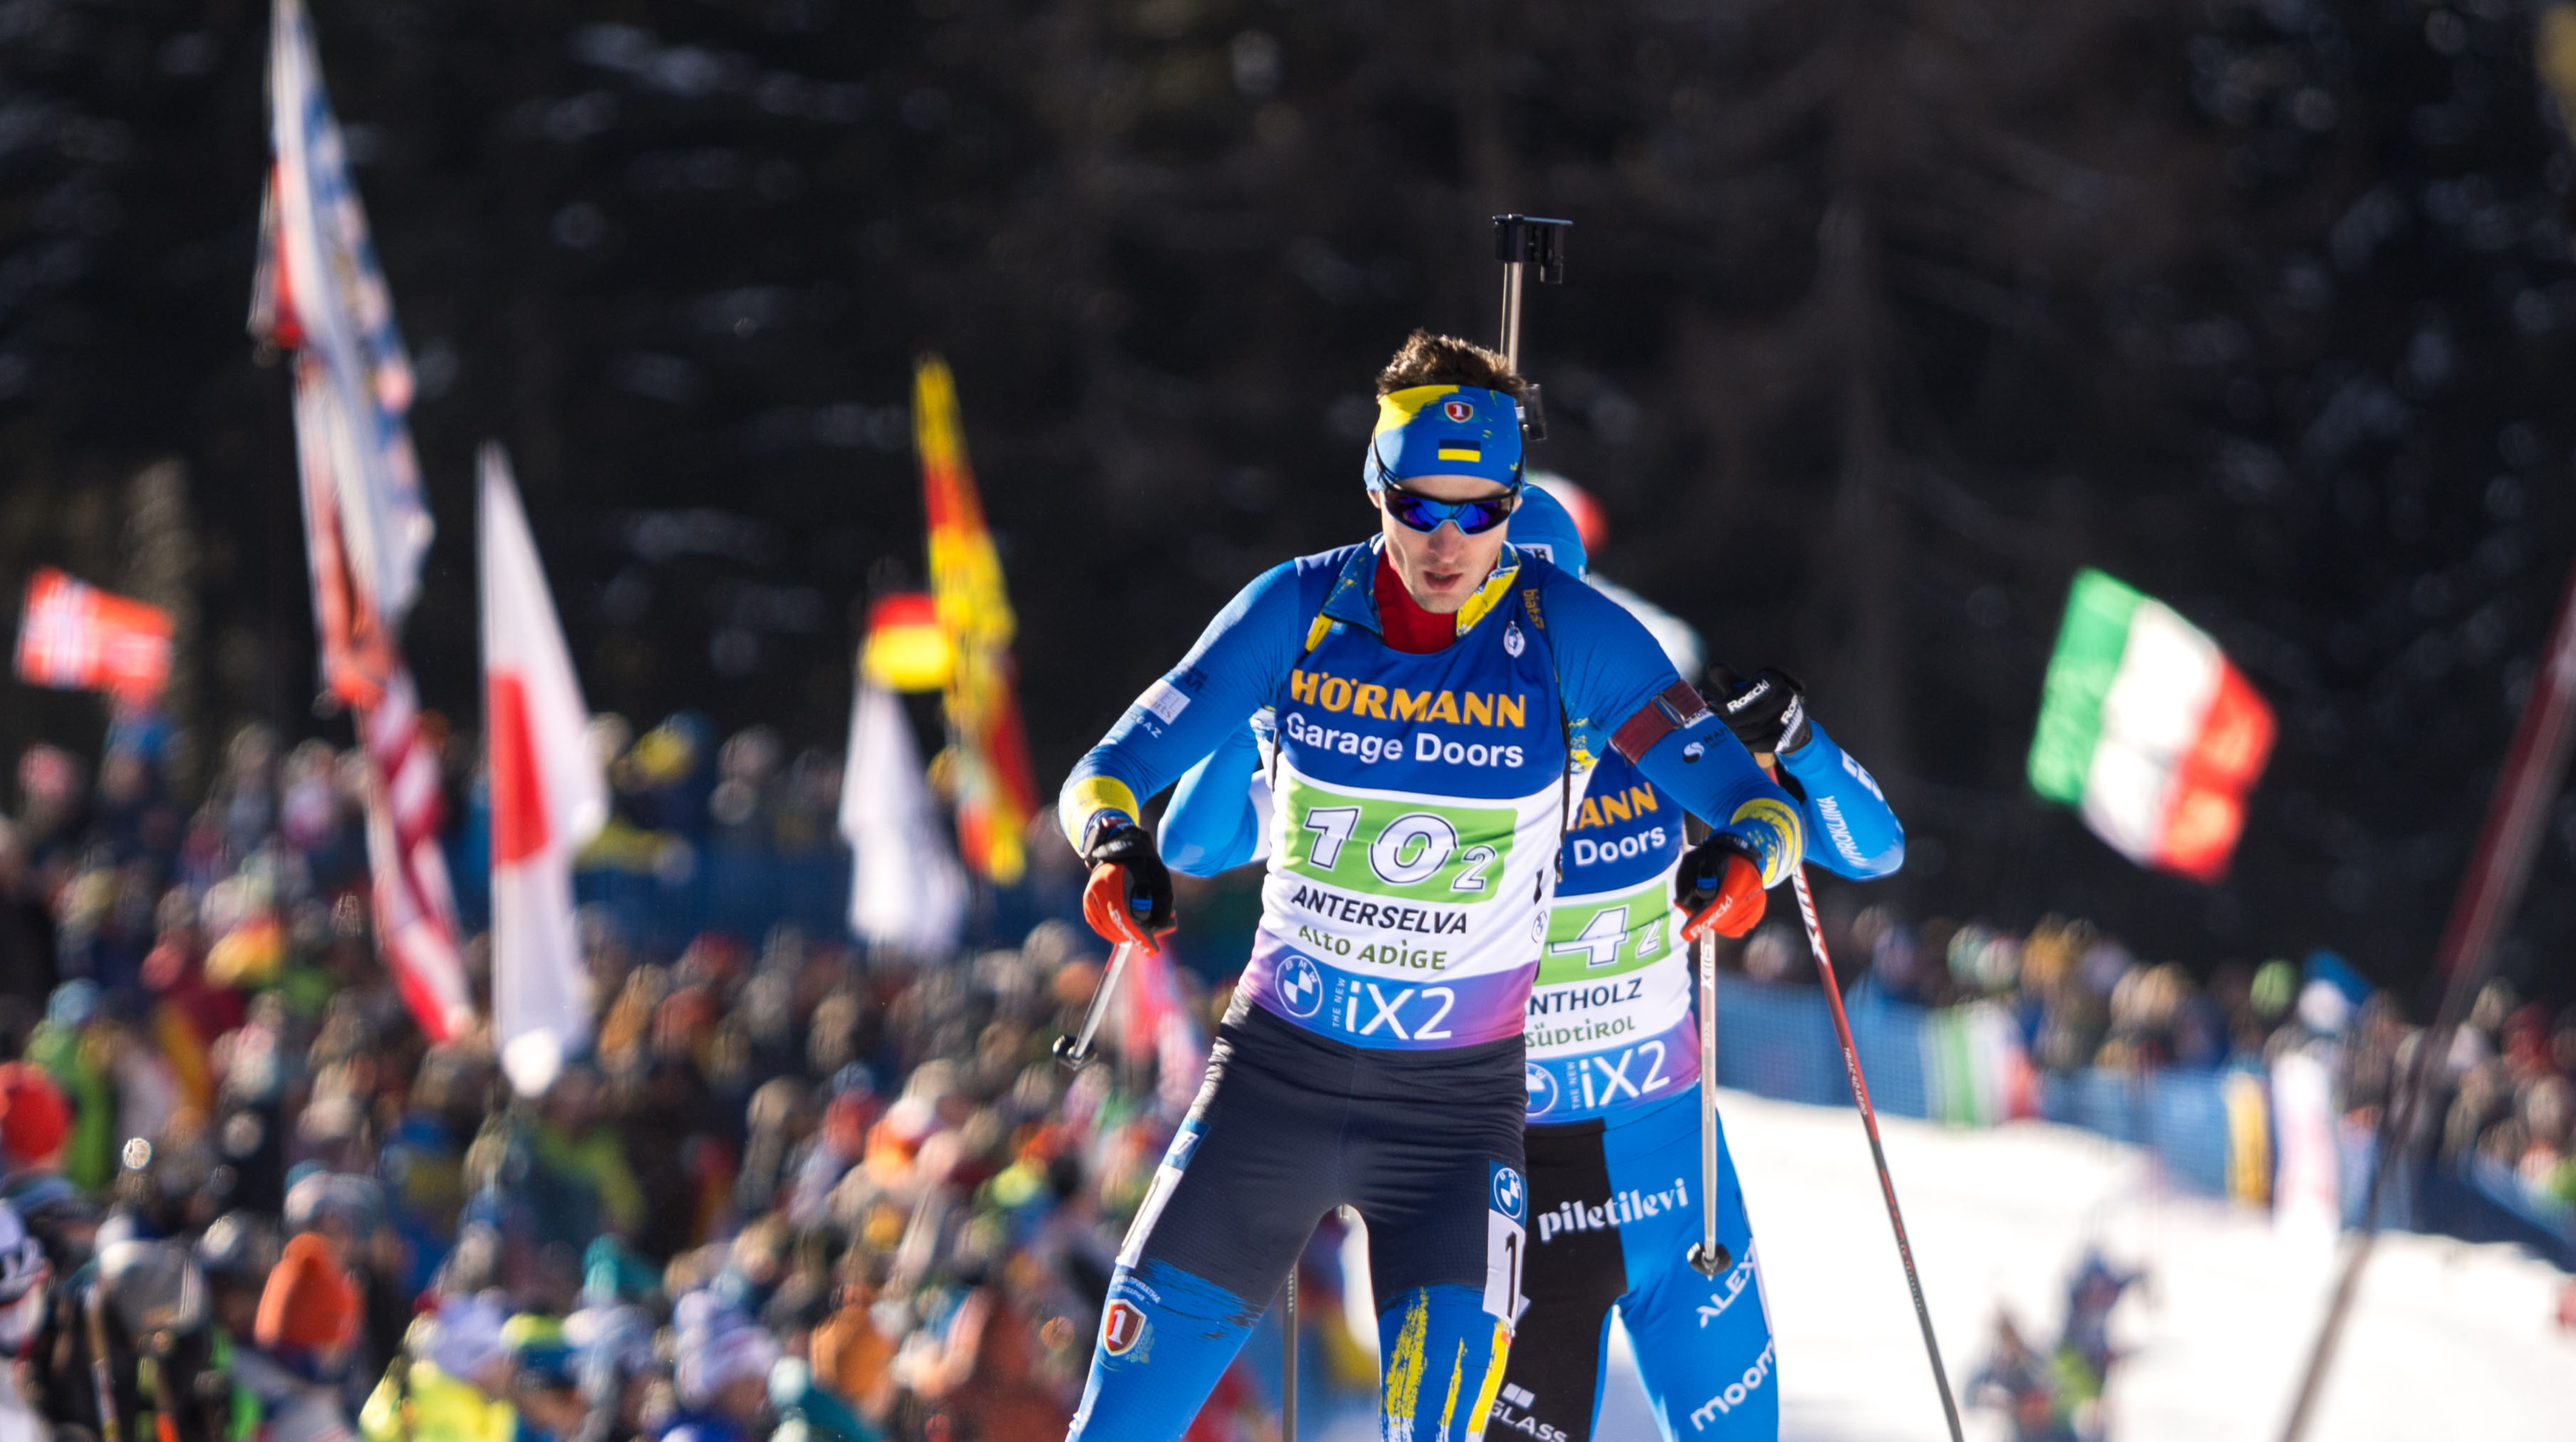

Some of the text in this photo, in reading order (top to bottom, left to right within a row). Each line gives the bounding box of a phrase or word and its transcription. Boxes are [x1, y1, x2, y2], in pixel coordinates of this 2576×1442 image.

[1291, 668, 1526, 729] HÖRMANN
[1287, 712, 1525, 768] Garage Doors
[1566, 782, 1658, 831] ANN
[1573, 826, 1666, 866] Doors
[1291, 884, 1468, 934] ANTERSELVA
[1549, 904, 1629, 968] 4
[1284, 959, 1318, 984] BMW
[1525, 977, 1643, 1016] NTHOLZ
[1332, 976, 1346, 1028] THE NEW
[1346, 980, 1455, 1041] iX2
[1579, 1039, 1671, 1109] iX2
[1537, 1177, 1688, 1243] piletilevi
